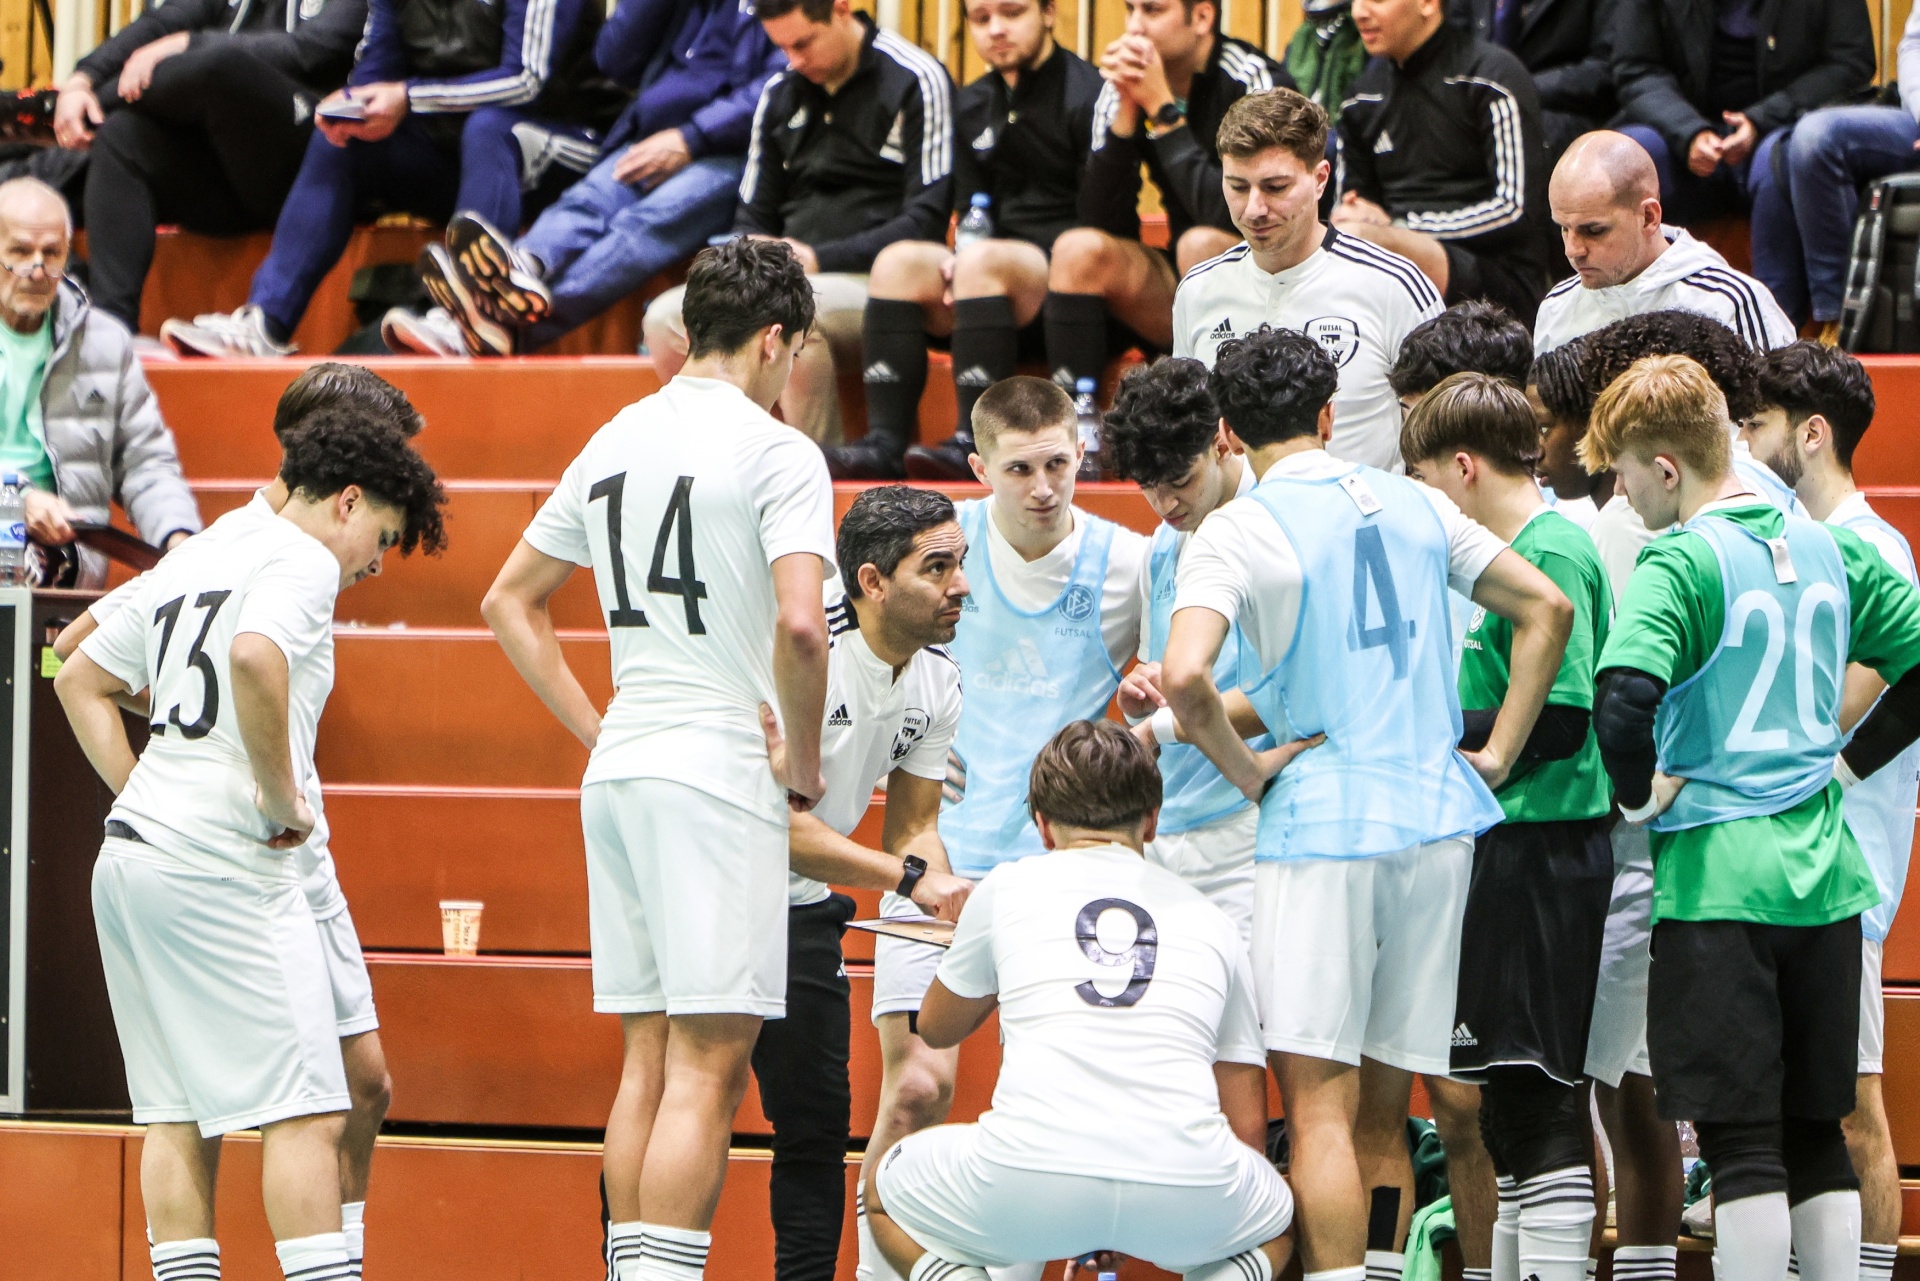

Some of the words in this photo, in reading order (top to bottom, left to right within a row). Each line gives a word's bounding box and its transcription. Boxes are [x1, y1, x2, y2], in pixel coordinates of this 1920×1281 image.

[1210, 331, 1236, 340] adidas
[1319, 324, 1342, 332] FUTSAL
[588, 471, 707, 635] 14
[1054, 627, 1091, 639] FUTSAL
[1346, 524, 1416, 681] 4
[150, 590, 232, 740] 13
[973, 671, 1060, 699] adidas
[1724, 582, 1847, 752] 20
[828, 718, 852, 727] adidas
[1074, 898, 1157, 1008] 9
